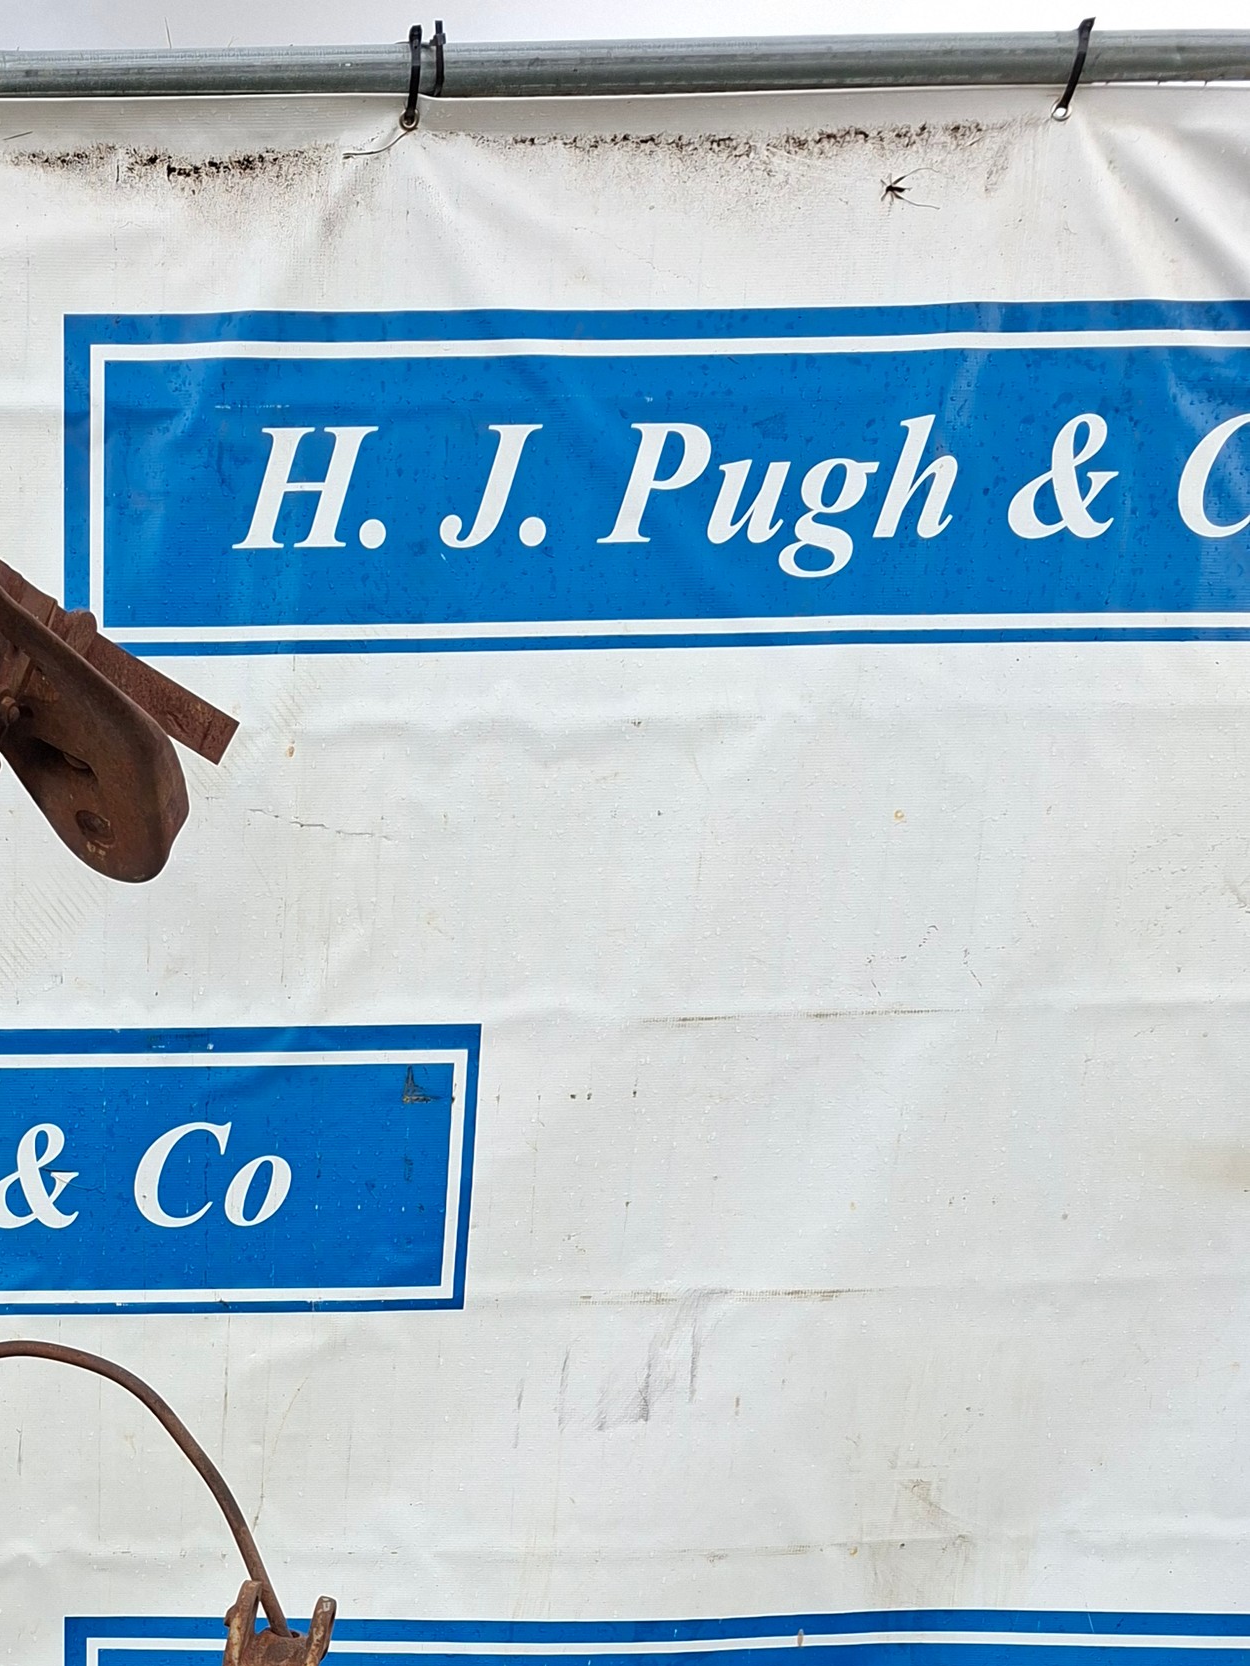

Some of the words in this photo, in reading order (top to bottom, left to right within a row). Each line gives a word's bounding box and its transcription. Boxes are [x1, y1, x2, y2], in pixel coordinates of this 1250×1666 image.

[232, 426, 386, 549] H.
[439, 424, 547, 549] J.
[597, 414, 958, 578] Pugh
[1007, 413, 1119, 539] &
[133, 1122, 292, 1228] Co
